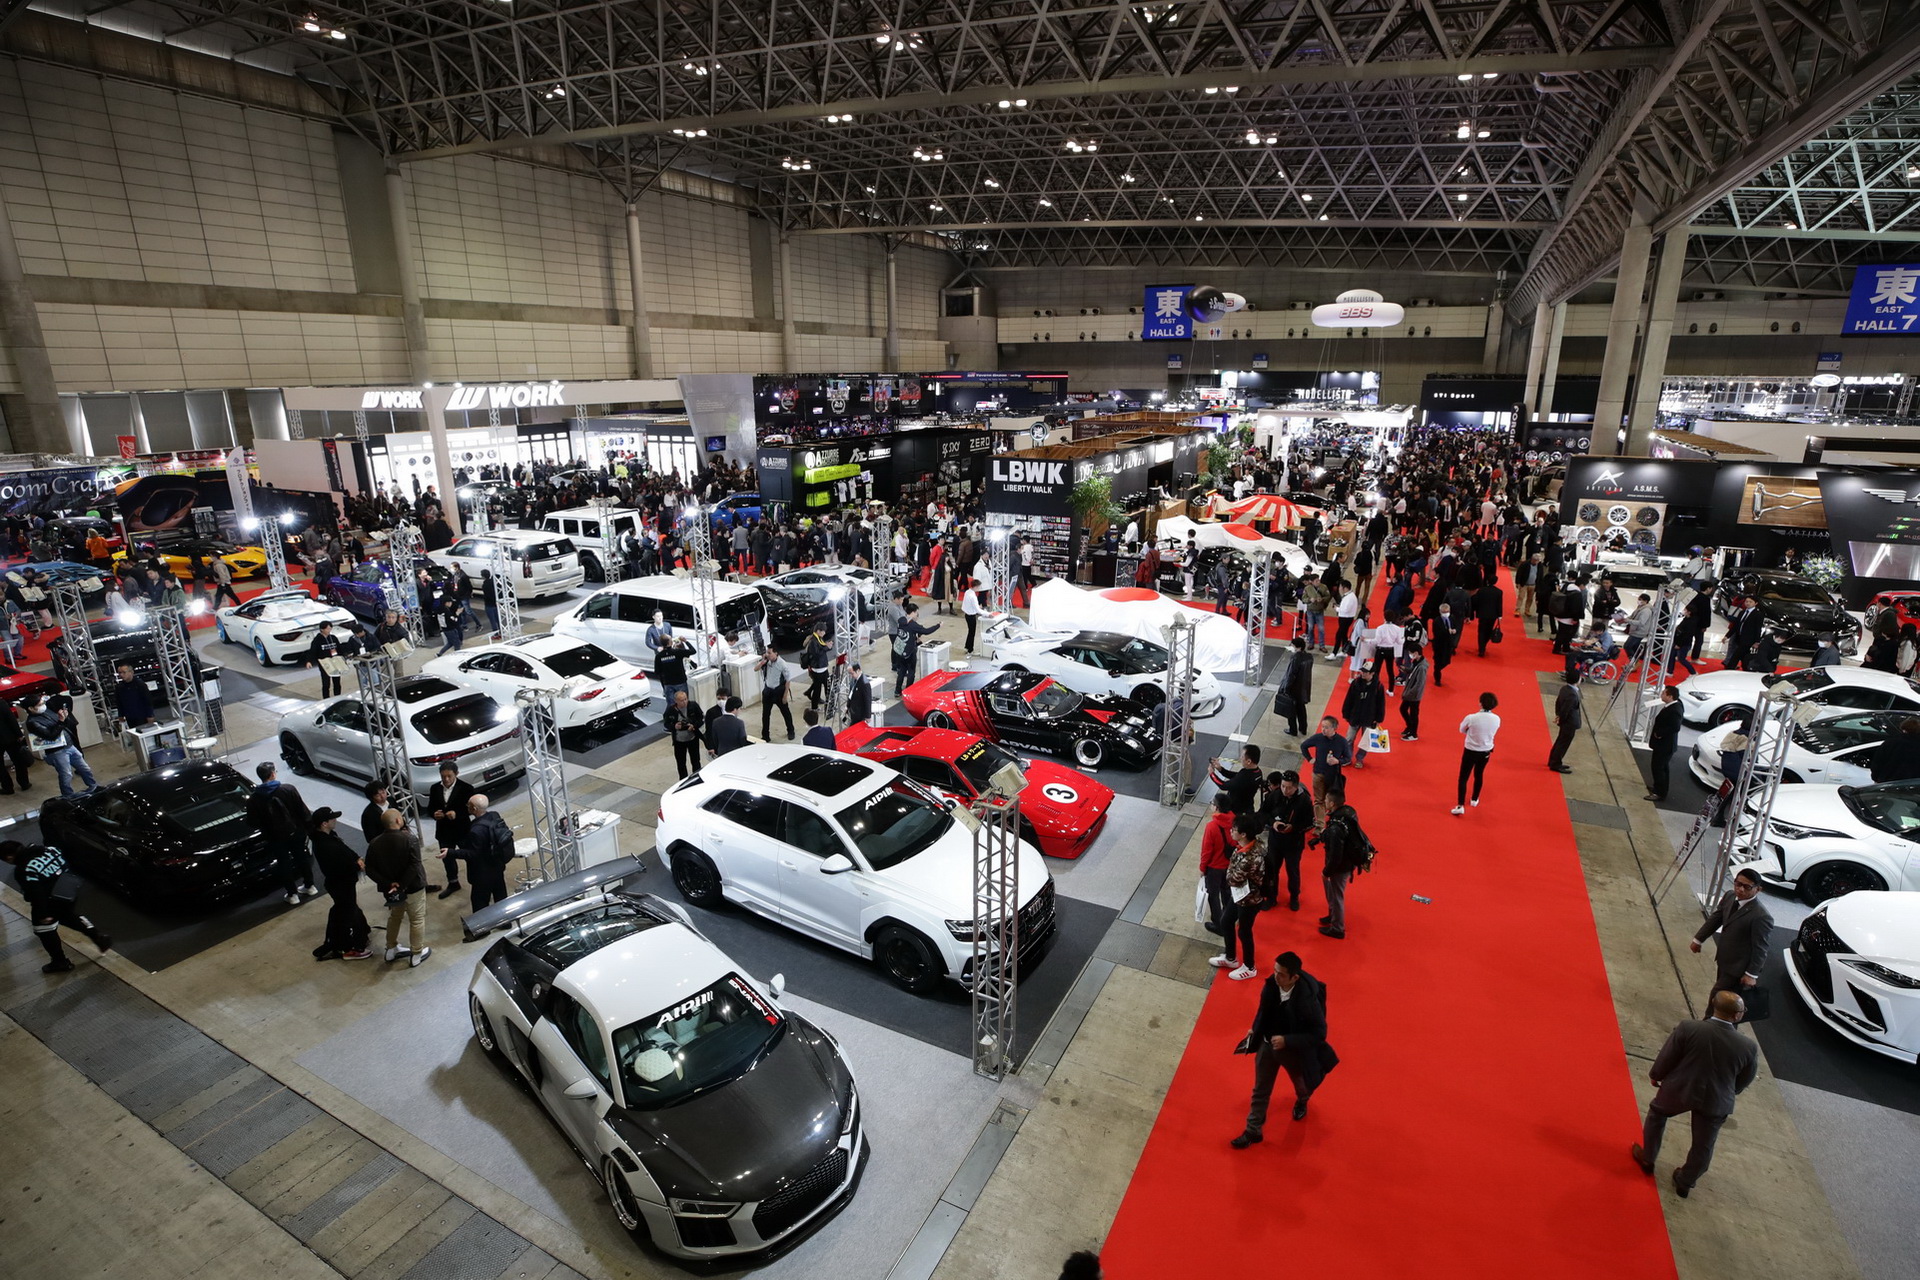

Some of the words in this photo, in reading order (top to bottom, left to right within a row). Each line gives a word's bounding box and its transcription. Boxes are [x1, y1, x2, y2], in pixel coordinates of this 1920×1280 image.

[1869, 267, 1920, 305] 東
[1155, 290, 1183, 318] 東
[1875, 306, 1904, 314] EAST
[1339, 307, 1373, 319] BBS
[1854, 320, 1898, 331] HALL
[1901, 314, 1918, 330] 7
[1150, 329, 1175, 337] HALL
[1175, 324, 1185, 337] 8
[1842, 376, 1904, 385] SUBARU
[380, 391, 424, 409] WORK
[488, 385, 565, 409] WORK
[1298, 389, 1352, 400] MODELLISTA
[993, 460, 1065, 485] LBWK
[1003, 483, 1031, 493] LIBERTY
[1032, 485, 1053, 495] WALK
[999, 739, 1053, 754] ADVAN
[1045, 788, 1075, 800] 3
